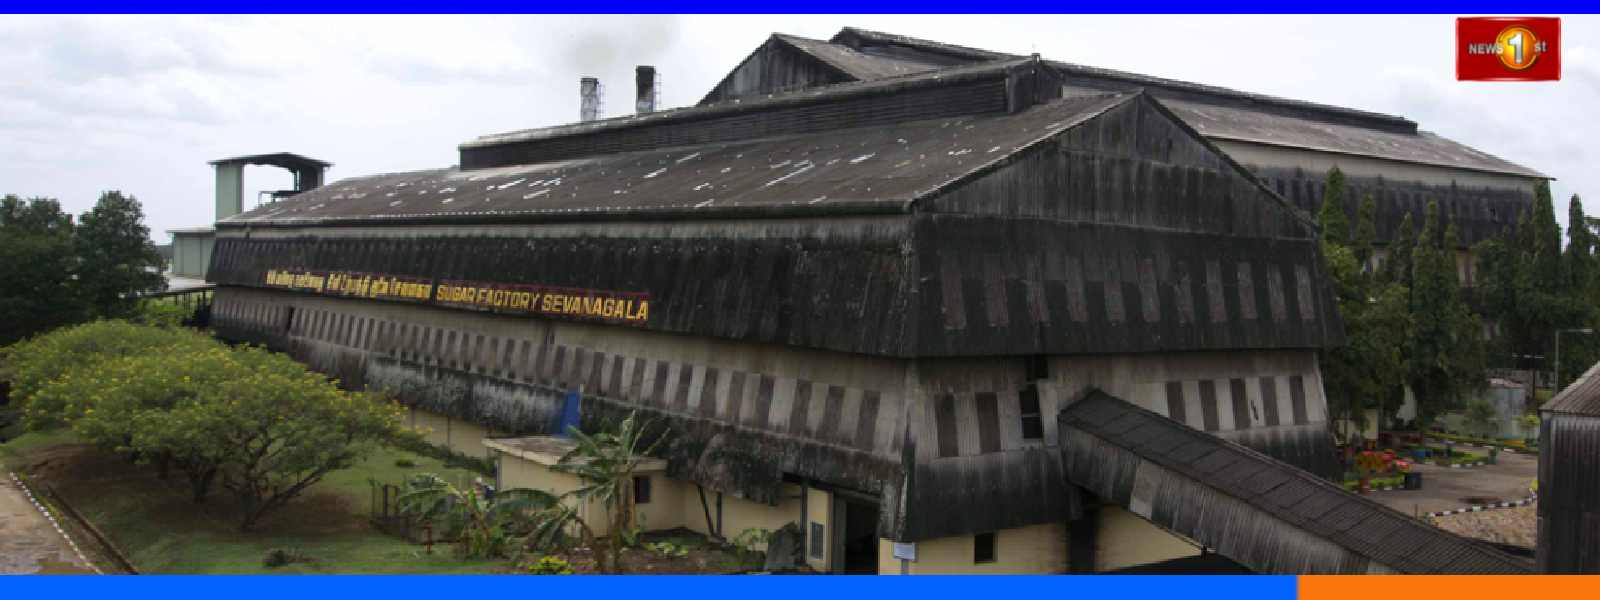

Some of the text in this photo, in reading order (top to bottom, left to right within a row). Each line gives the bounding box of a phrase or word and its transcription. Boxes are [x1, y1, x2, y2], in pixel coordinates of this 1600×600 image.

[436, 284, 475, 303] SUGAR
[477, 288, 539, 309] FACTORY
[542, 294, 649, 320] SEVANAGALA
